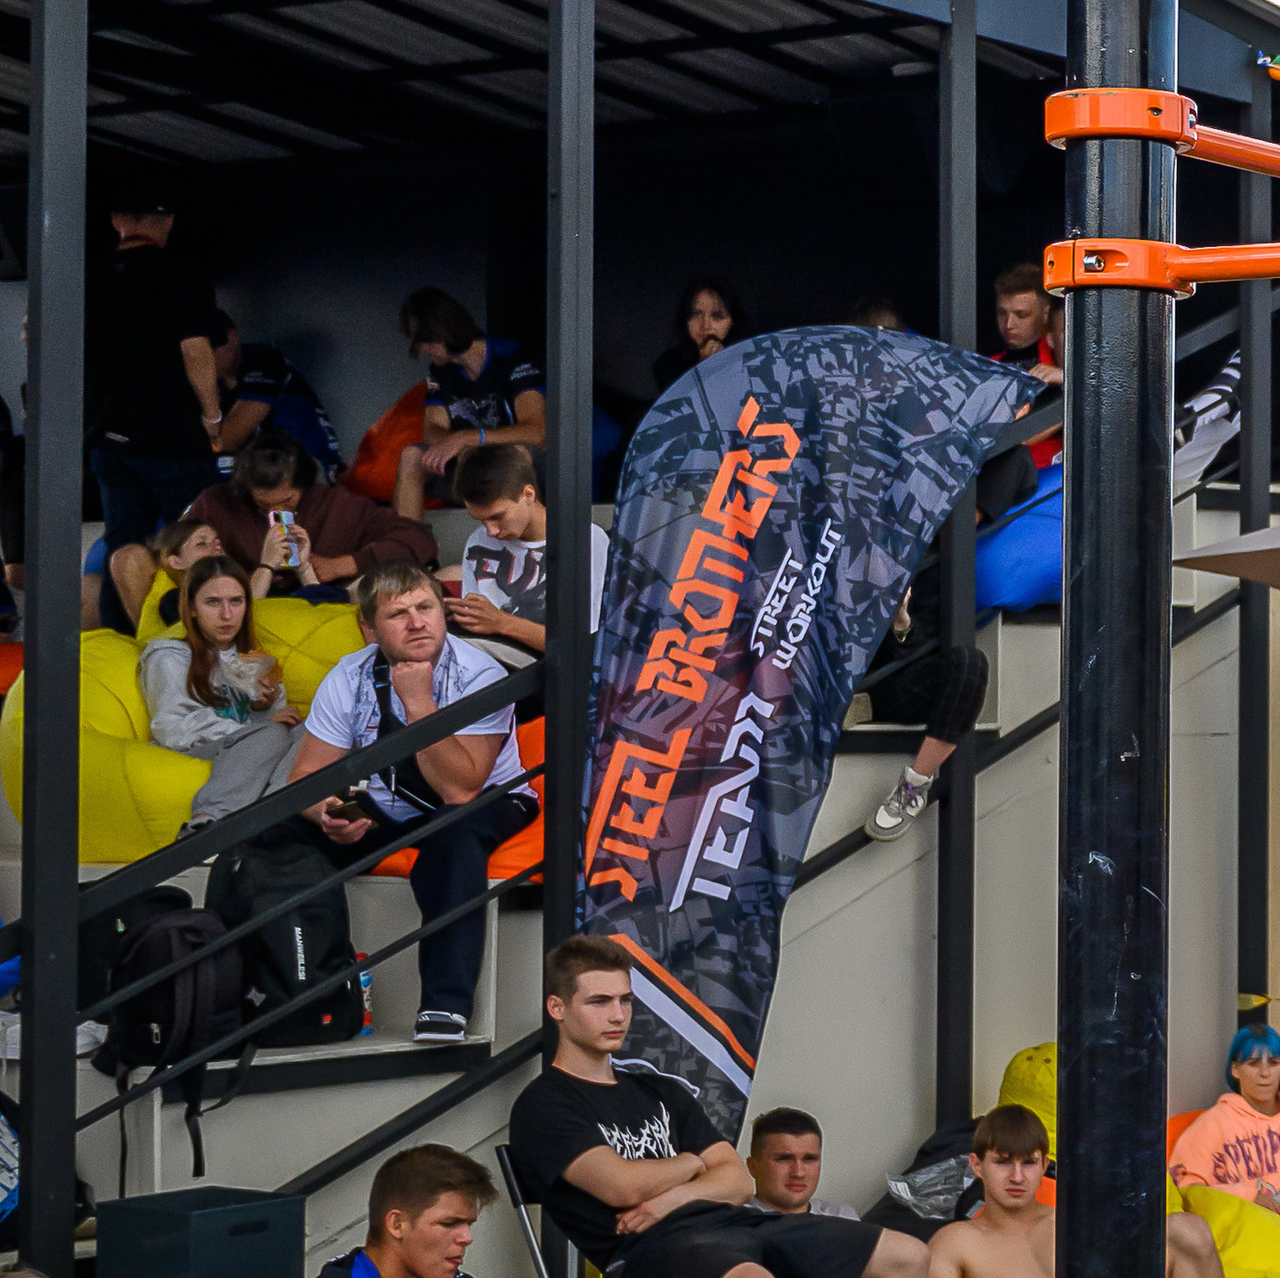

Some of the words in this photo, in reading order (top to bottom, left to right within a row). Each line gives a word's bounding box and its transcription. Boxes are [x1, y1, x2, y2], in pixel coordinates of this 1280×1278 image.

[635, 396, 801, 703] BROTHERS
[750, 547, 803, 658] STREET
[772, 517, 842, 670] WORKOUT
[585, 727, 693, 903] STEEL
